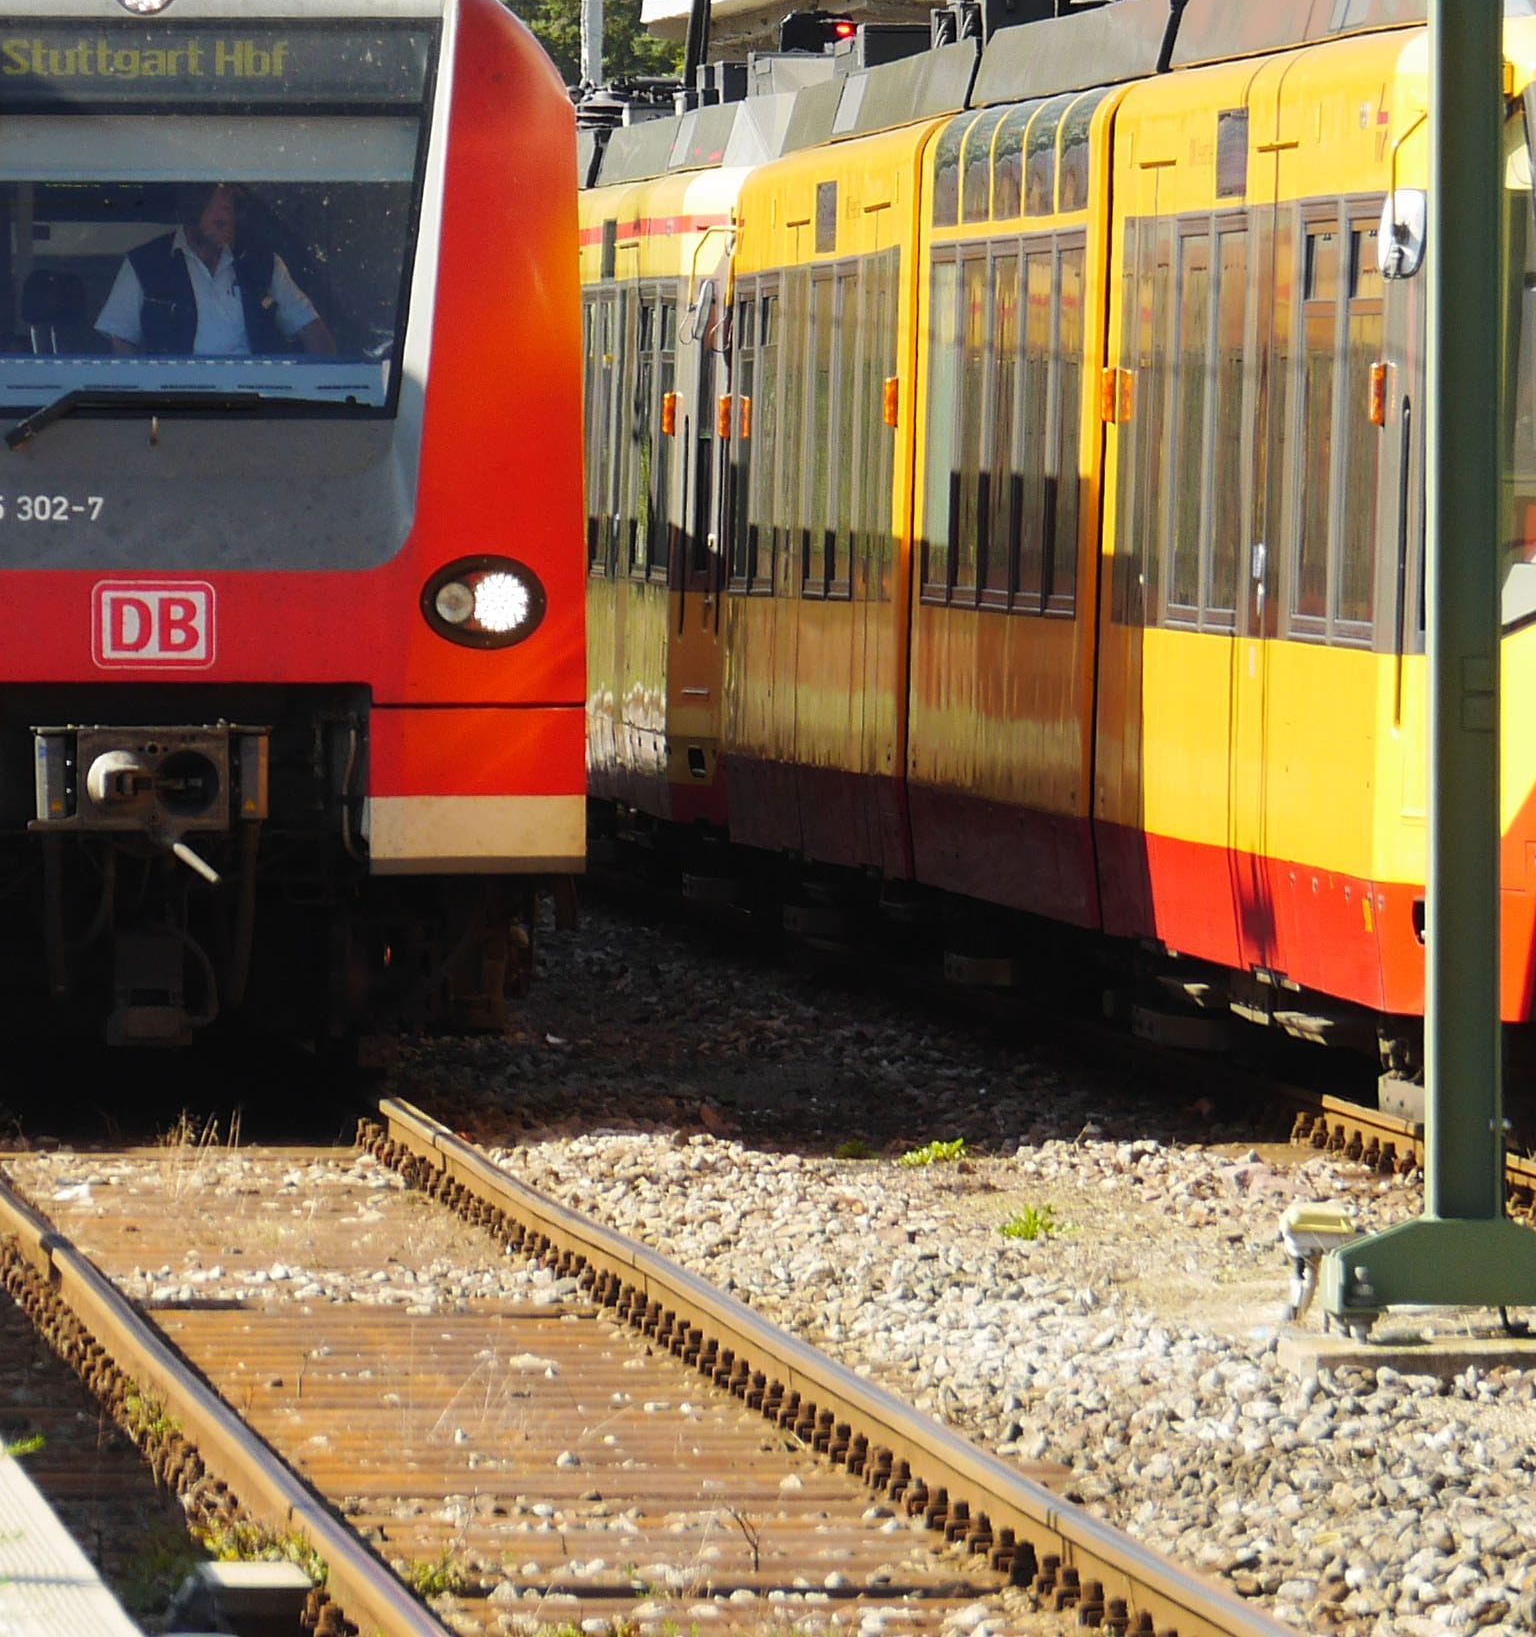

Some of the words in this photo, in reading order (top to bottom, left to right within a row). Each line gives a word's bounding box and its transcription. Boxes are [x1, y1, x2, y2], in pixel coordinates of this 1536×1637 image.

[1, 38, 204, 78] Stuttgart
[215, 39, 287, 77] Hbf
[16, 491, 105, 523] 302-7
[108, 595, 200, 654] DB
